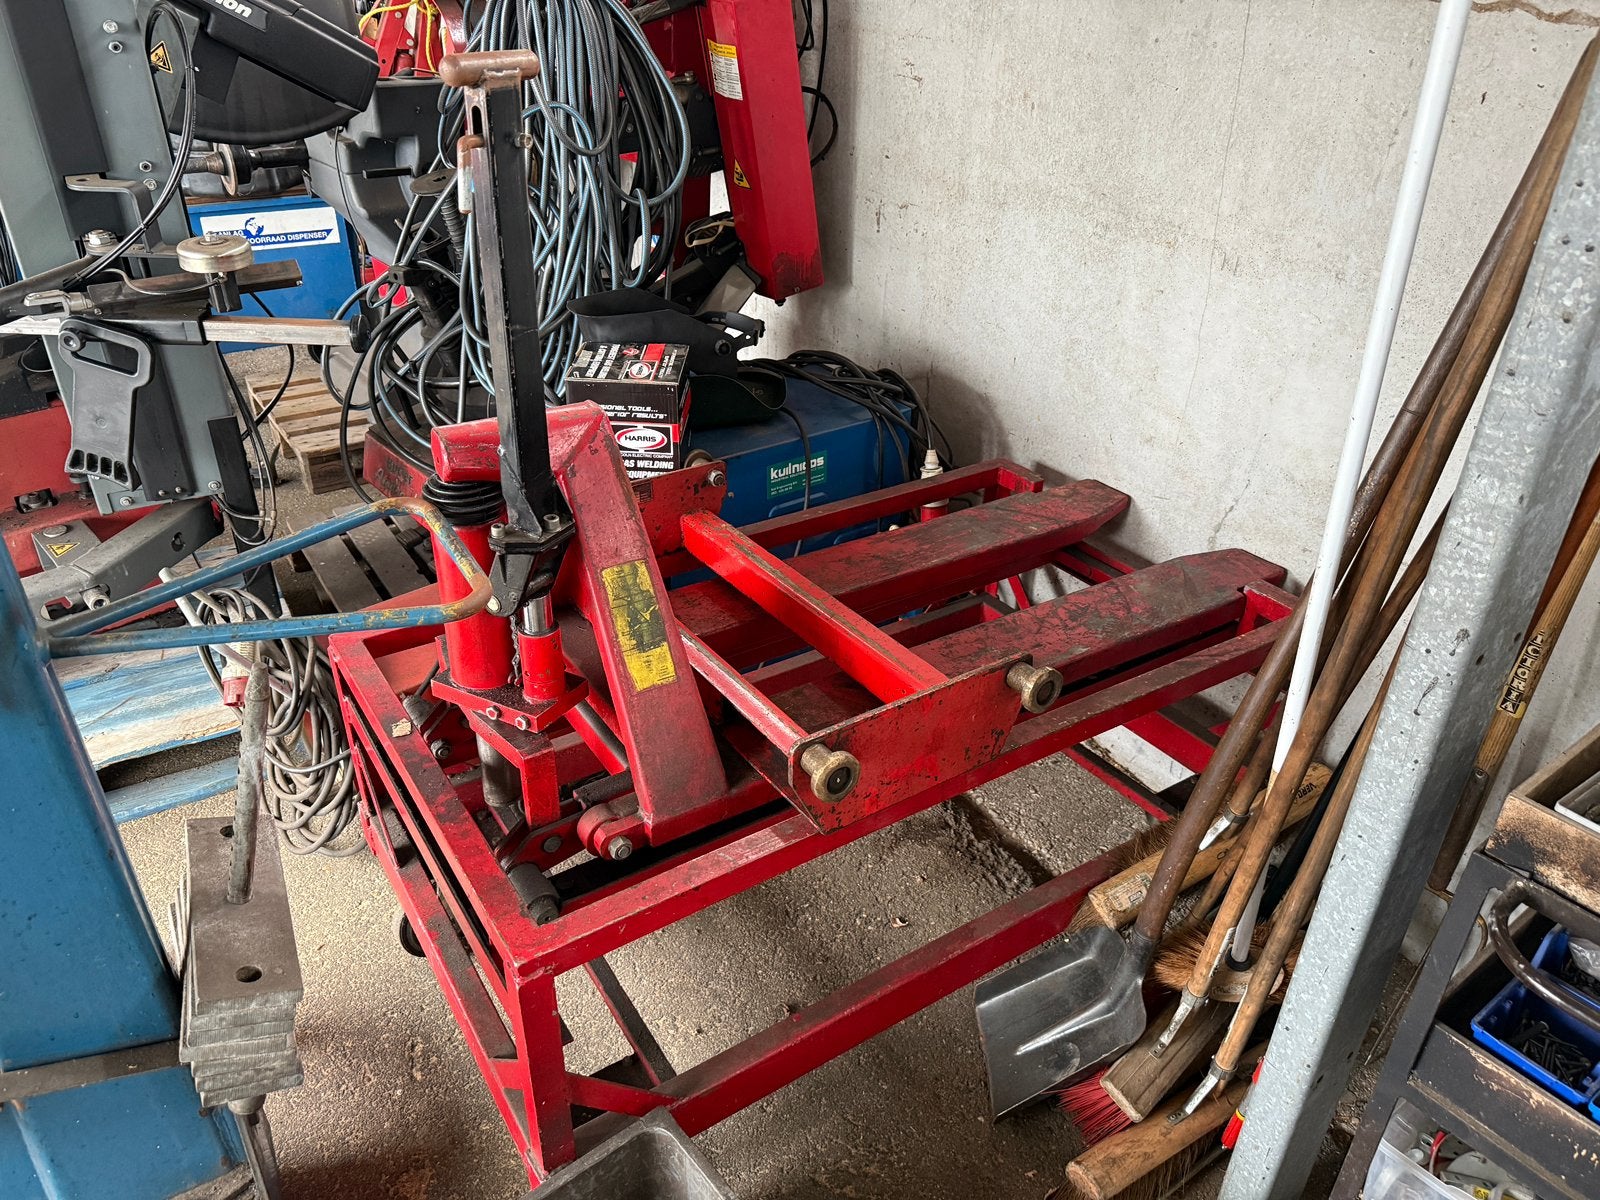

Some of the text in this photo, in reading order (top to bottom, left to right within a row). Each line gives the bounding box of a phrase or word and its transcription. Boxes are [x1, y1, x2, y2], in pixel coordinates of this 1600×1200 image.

[248, 231, 328, 244] OORRAAD DISPENSER
[622, 459, 674, 469] AS WELDING
